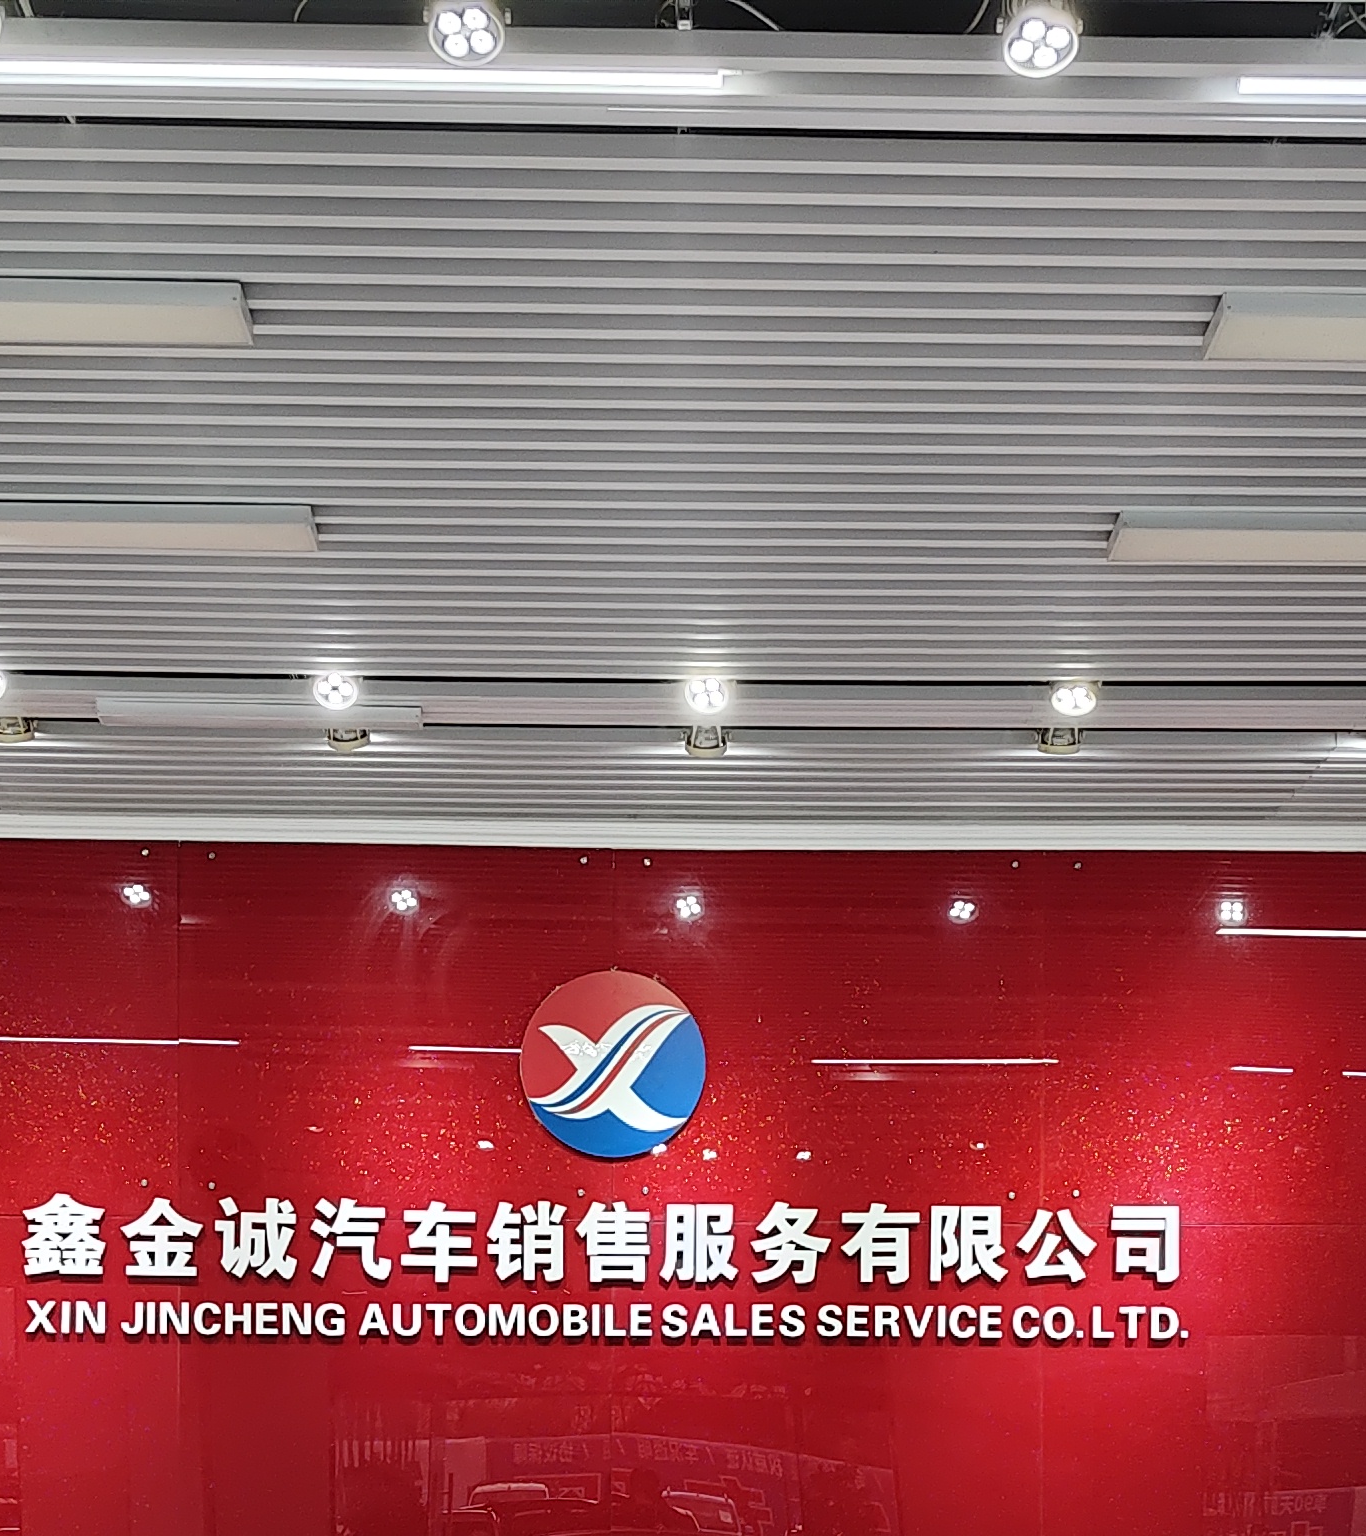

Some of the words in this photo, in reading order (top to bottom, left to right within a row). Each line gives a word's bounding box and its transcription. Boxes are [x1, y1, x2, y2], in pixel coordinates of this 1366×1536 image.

[22, 1194, 1184, 1284] 鑫金诚汽车销售服务有限公司
[25, 1300, 107, 1335] XIN
[121, 1301, 347, 1337] JINCHENG
[358, 1302, 654, 1339] AUTOMOBILE
[661, 1303, 806, 1339] SALES
[815, 1304, 1003, 1340] SERVICE
